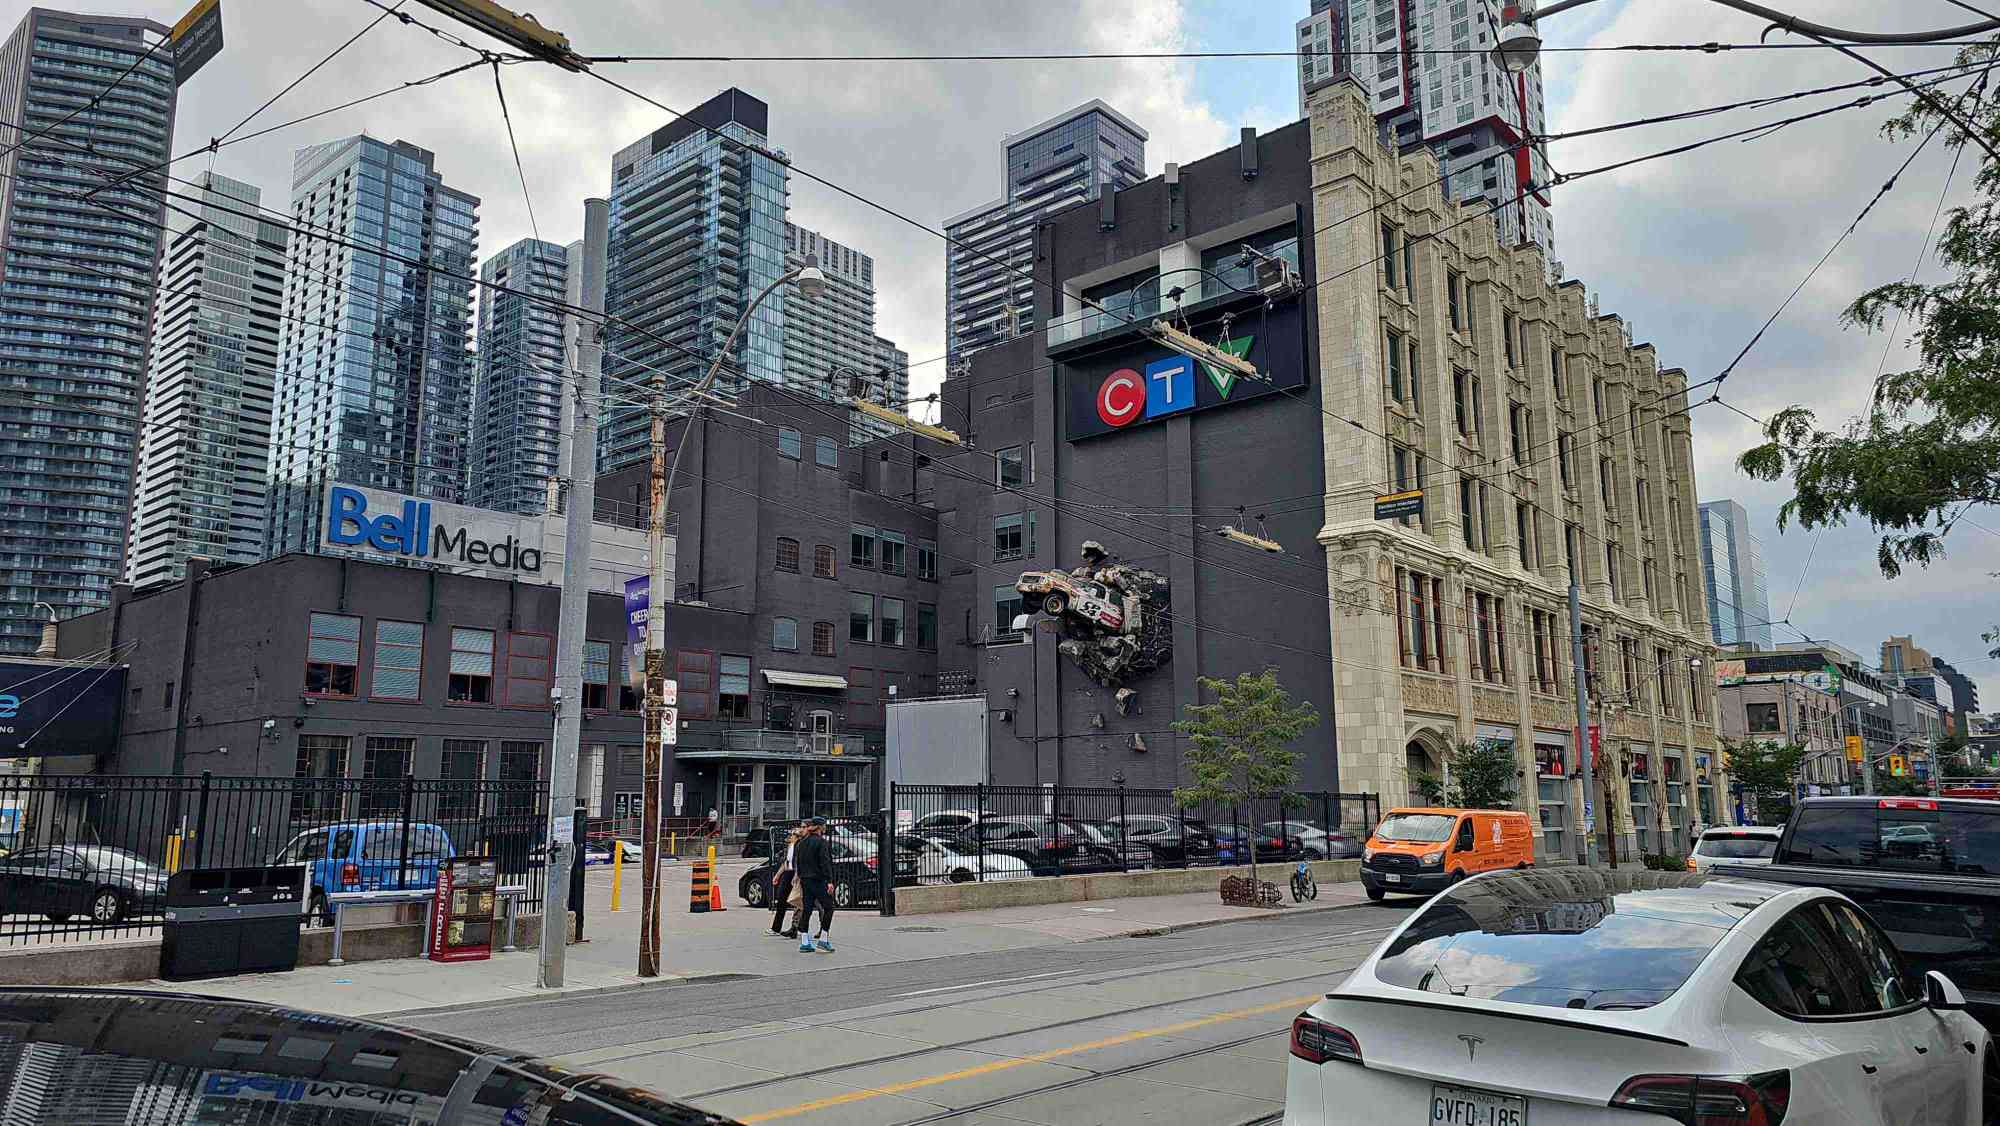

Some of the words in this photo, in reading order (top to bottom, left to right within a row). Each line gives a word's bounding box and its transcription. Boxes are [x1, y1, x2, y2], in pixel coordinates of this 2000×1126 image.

[327, 486, 431, 557] Bell
[433, 524, 541, 573] Media
[1490, 1106, 1520, 1126] 185
